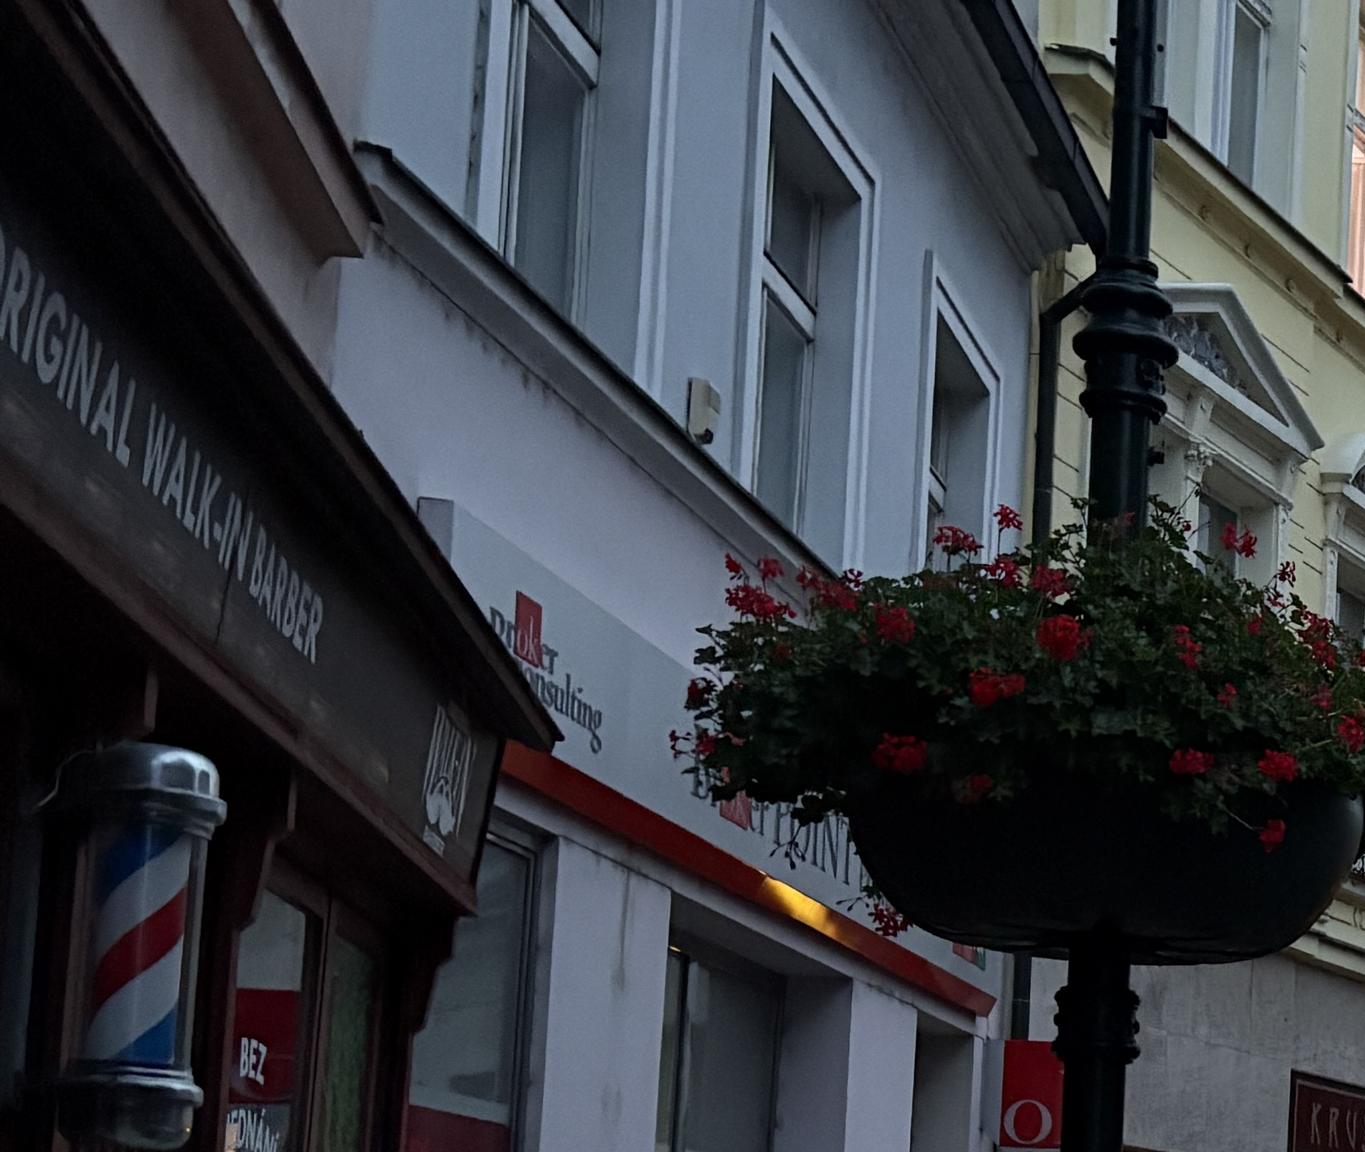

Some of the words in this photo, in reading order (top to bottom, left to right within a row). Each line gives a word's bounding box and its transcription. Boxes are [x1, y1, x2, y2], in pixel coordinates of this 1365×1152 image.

[0, 226, 136, 469] RIGINAL
[142, 402, 254, 582] WALK-IN
[248, 524, 324, 665] BARBER
[516, 664, 603, 754] onsulting
[239, 1036, 268, 1086] BEZ
